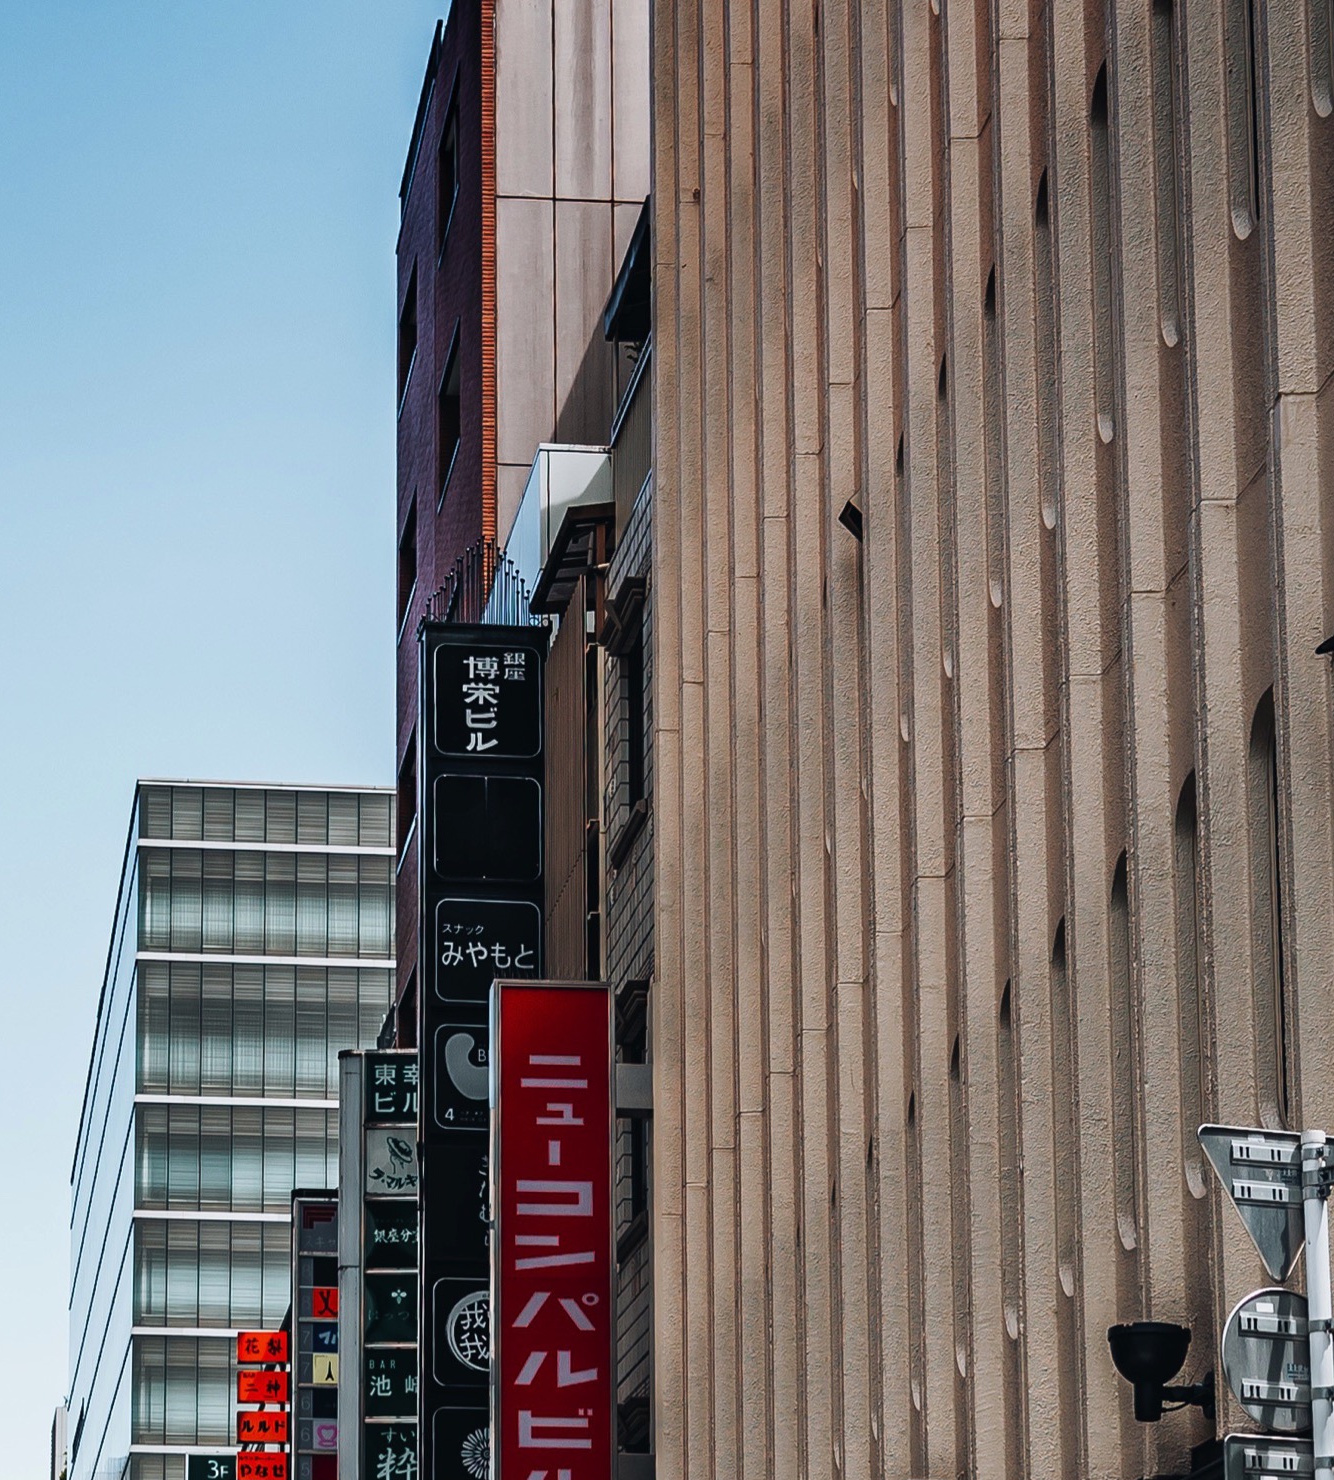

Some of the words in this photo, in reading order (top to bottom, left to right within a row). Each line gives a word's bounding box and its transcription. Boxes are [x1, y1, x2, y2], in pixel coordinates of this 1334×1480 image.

[503, 650, 527, 682] 銀座
[462, 655, 501, 753] 博栄ビル
[441, 922, 486, 935] スナック
[440, 941, 536, 971] みやもと
[374, 1091, 419, 1113] ビル
[444, 1108, 455, 1121] 4
[244, 1337, 283, 1356] 花梨
[368, 1359, 397, 1370] BAR
[240, 1417, 286, 1434] ルルド
[207, 1459, 229, 1479] 3F
[239, 1463, 285, 1478] やなせ
